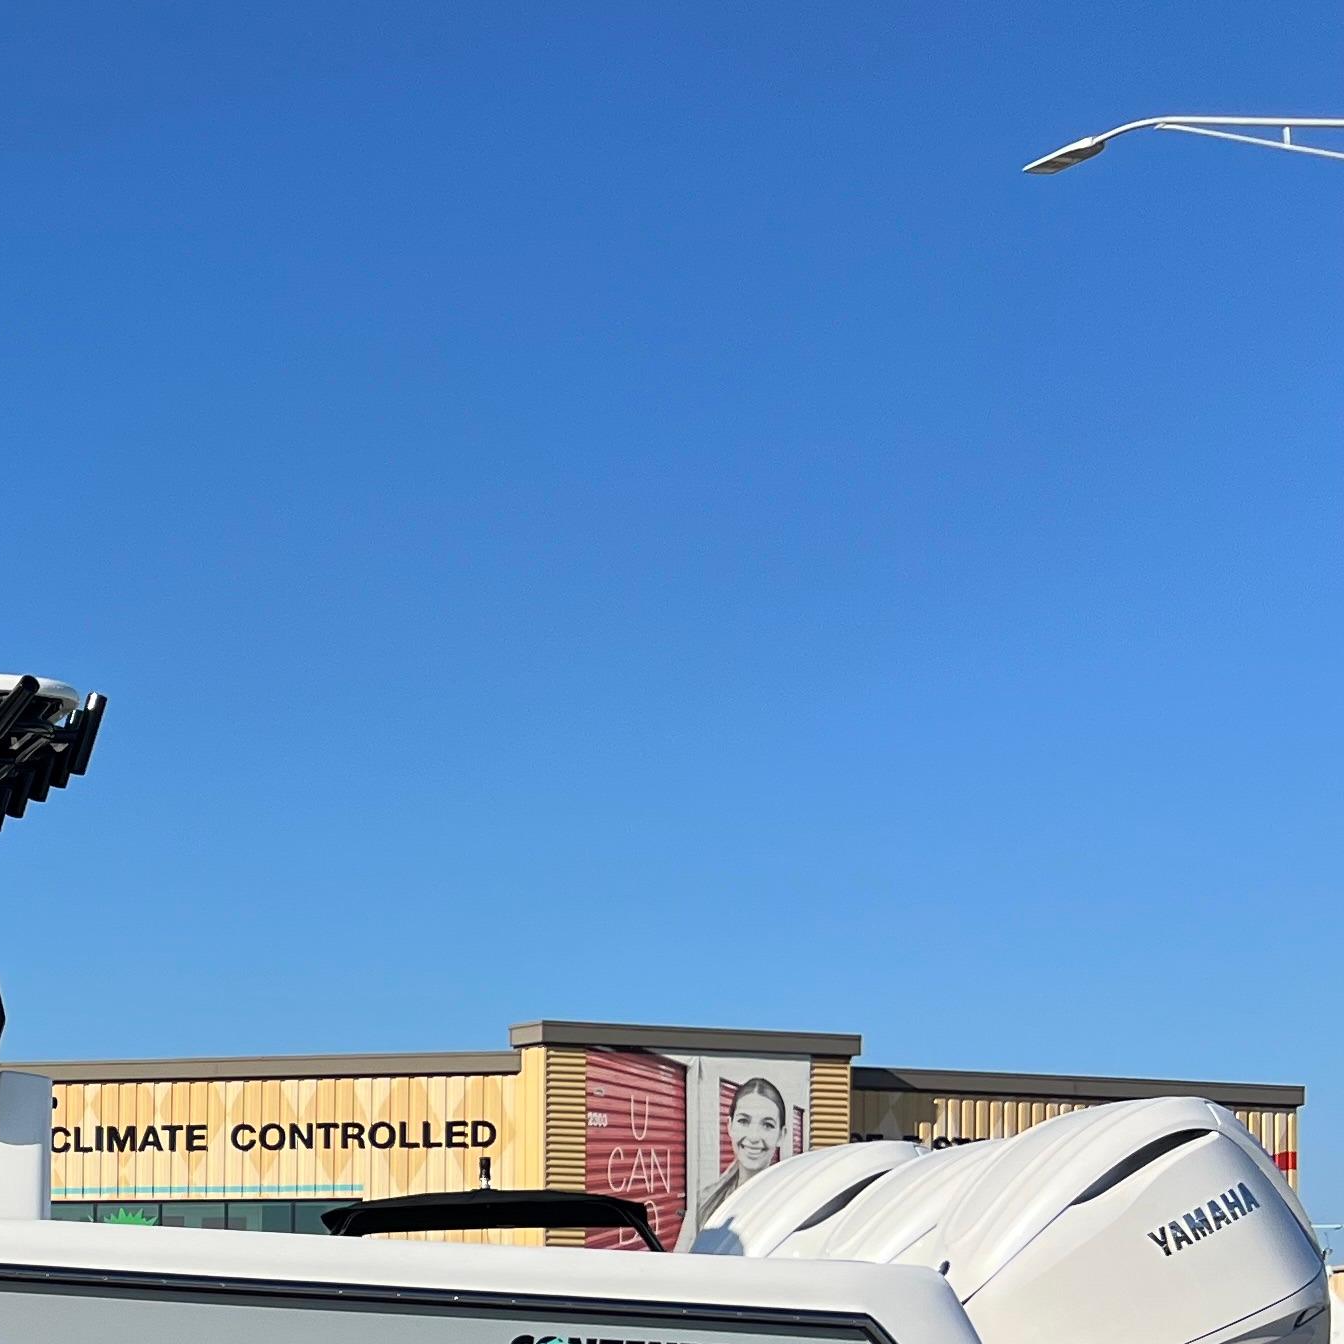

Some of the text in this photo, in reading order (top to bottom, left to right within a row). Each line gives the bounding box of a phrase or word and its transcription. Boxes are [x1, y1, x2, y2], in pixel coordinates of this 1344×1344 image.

[51, 1120, 497, 1152] CLIMATE CONTROLLED
[629, 1094, 650, 1141] U
[607, 1146, 671, 1193] CAN
[1147, 1182, 1260, 1256] YAMAHA
